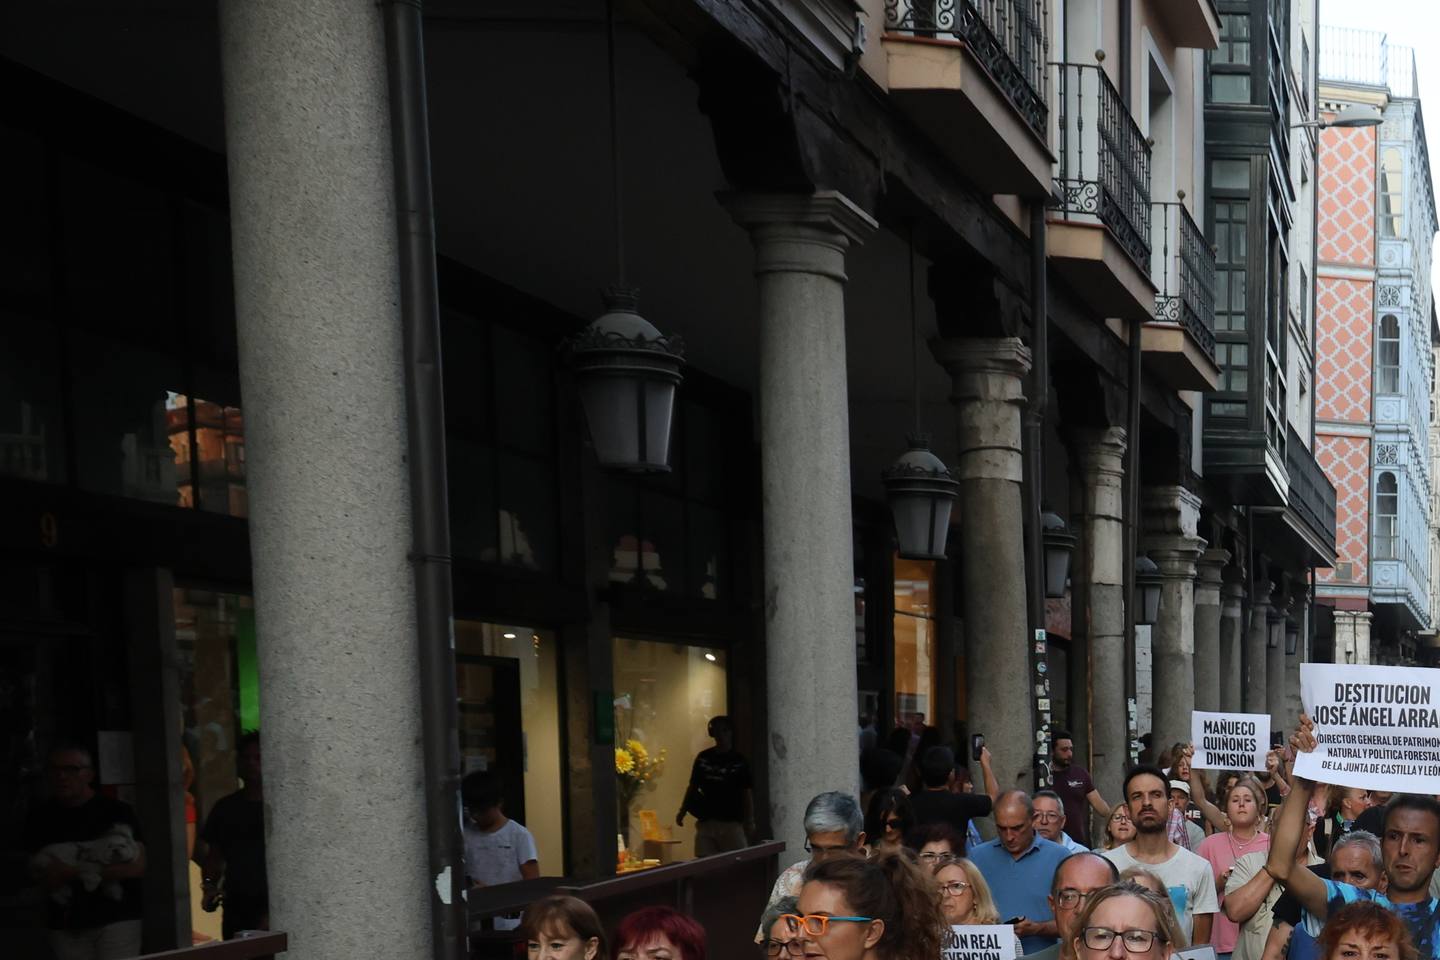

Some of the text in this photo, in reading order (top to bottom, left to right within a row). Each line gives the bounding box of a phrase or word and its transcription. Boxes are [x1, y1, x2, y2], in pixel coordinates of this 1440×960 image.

[40, 511, 58, 548] 9
[1335, 683, 1431, 705] DESTITUCION
[1313, 703, 1347, 726] JOSÉ
[1350, 703, 1396, 728] ÁNGEL
[1203, 719, 1256, 736] MAÑUECO
[1203, 735, 1257, 752] QUIÑONES
[1316, 733, 1357, 747] (DIRECTOR
[1357, 734, 1393, 747] GENERAL
[1393, 735, 1403, 747] DE
[1206, 751, 1255, 768] DIMISIÓN
[1327, 747, 1362, 759] NATURAL
[1362, 749, 1369, 759] Y
[1368, 747, 1403, 761] POLÍTICA
[1321, 760, 1332, 770] DE
[1332, 761, 1344, 771] LA
[1343, 762, 1369, 773] JUNTA
[1370, 763, 1381, 774] DE
[1380, 764, 1418, 776] CASTILLA
[1418, 765, 1424, 776] Y
[970, 933, 1002, 949] REAL
